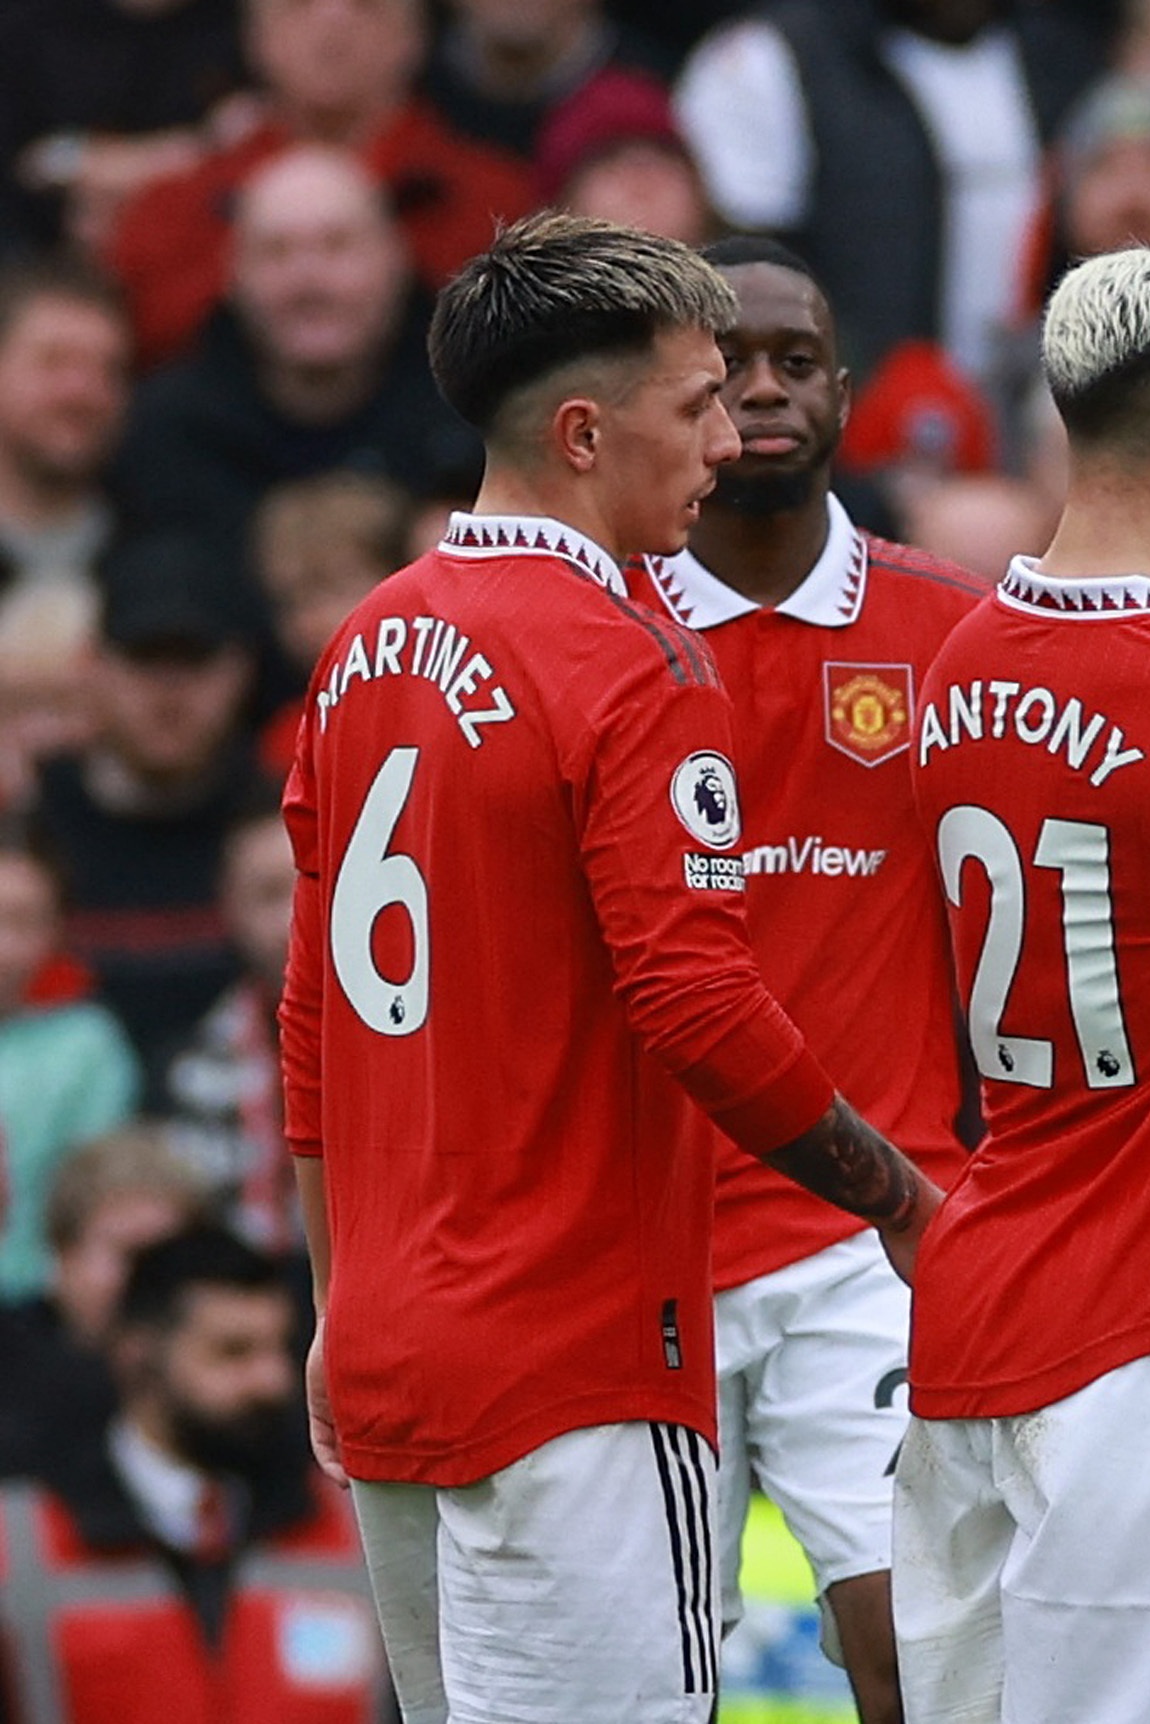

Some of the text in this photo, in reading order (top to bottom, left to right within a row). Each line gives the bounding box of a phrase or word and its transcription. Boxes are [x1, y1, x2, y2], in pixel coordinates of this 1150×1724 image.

[918, 680, 1144, 787] ANTONY
[330, 747, 430, 1036] 6
[937, 804, 1136, 1089] 21
